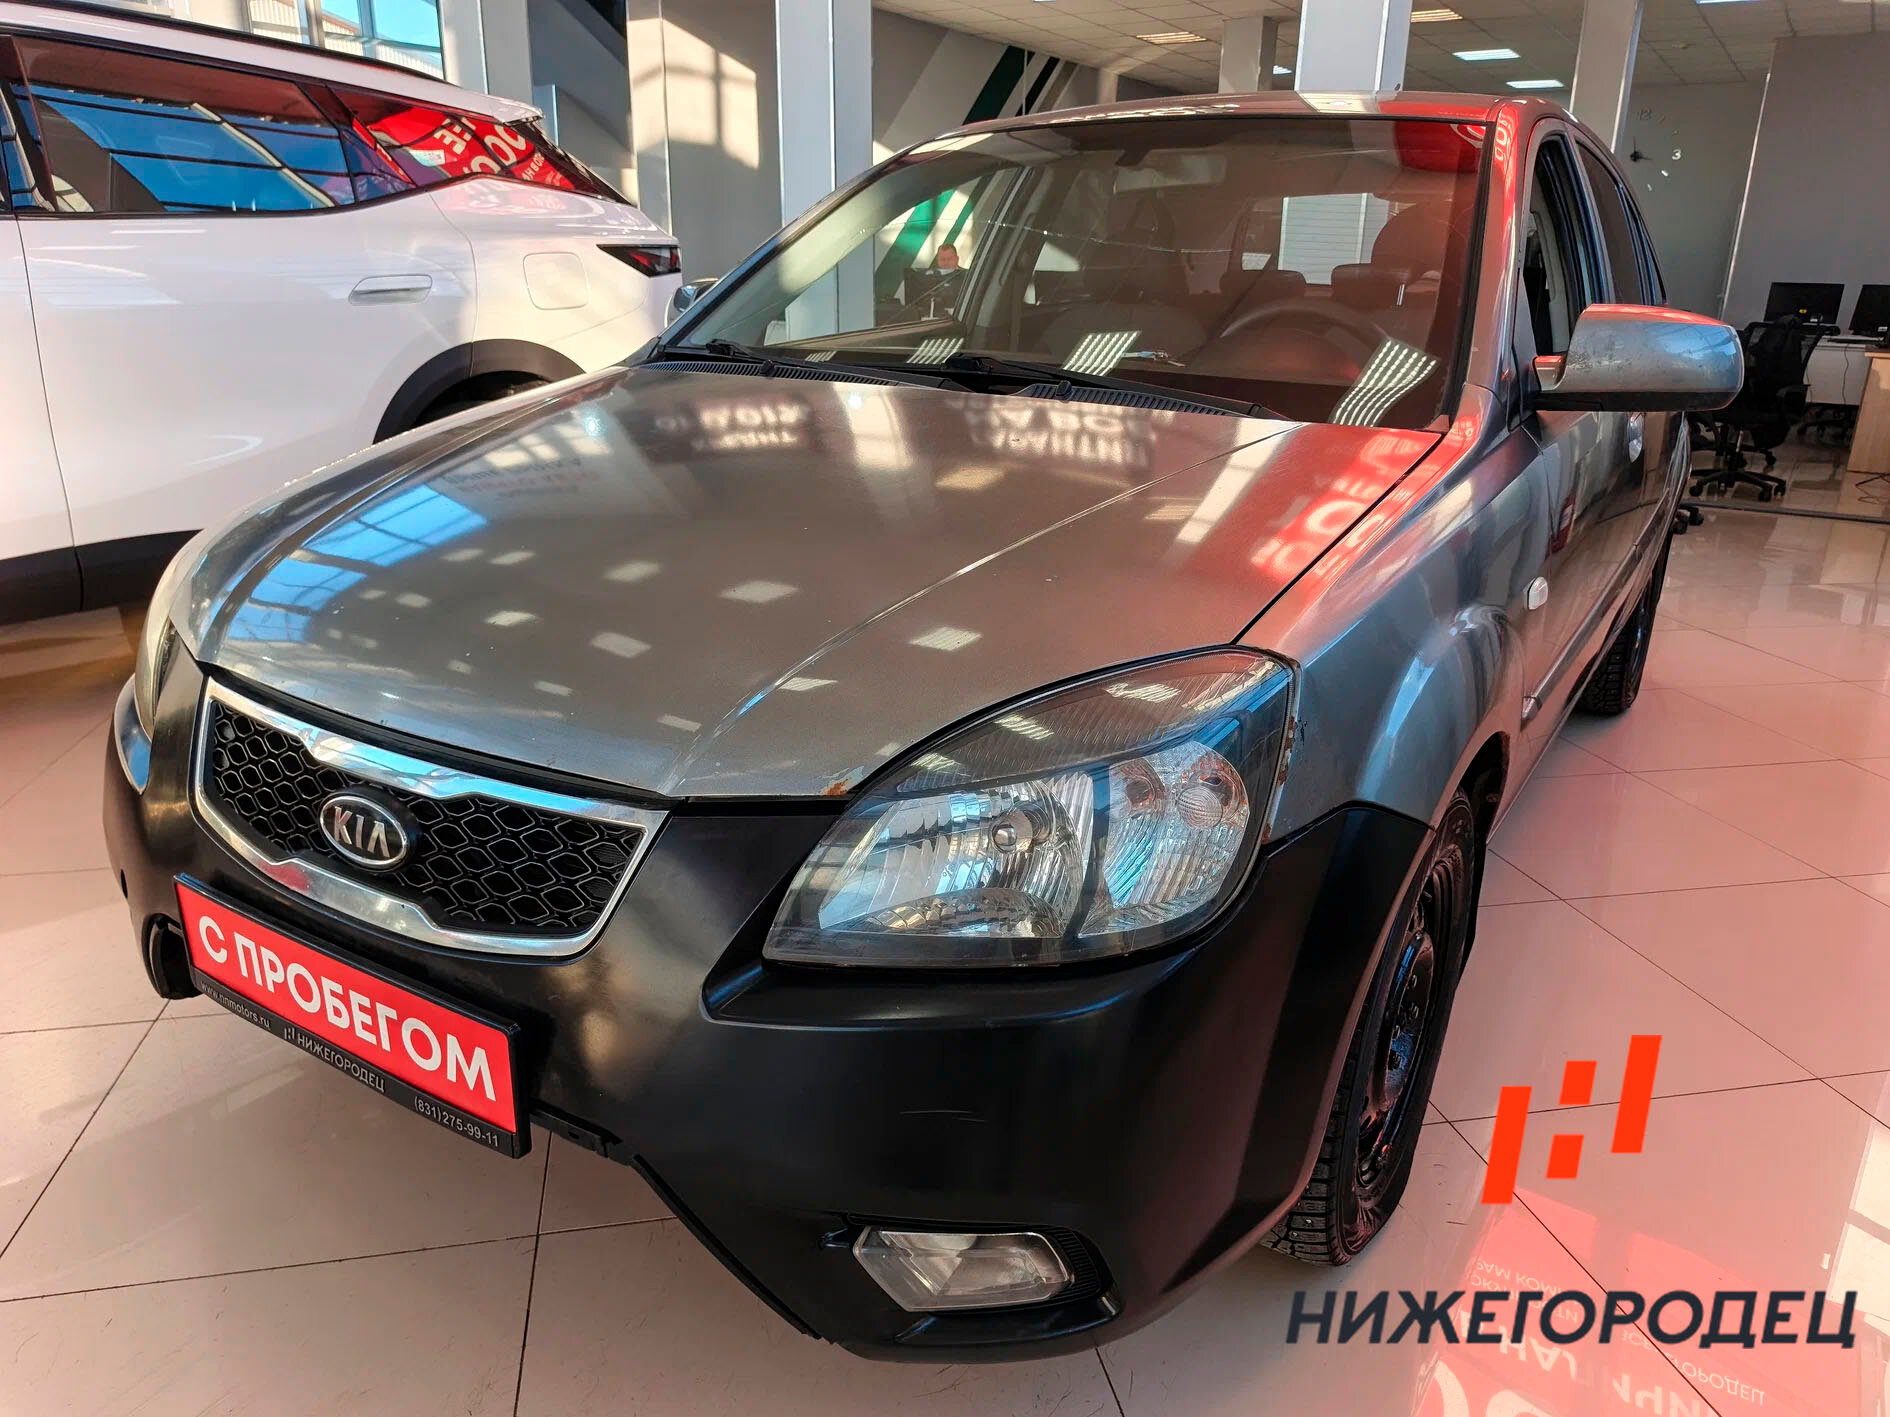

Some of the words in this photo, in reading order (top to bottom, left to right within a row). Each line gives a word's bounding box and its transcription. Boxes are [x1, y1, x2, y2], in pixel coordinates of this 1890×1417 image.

[1672, 149, 1682, 160] 3
[334, 806, 390, 858] KIA
[199, 915, 228, 964] С
[234, 931, 497, 1102] ПРОБЕГОМ
[201, 981, 271, 1030] www.nnmotors.ru
[297, 1032, 385, 1093] НИЖЕГОРОДЕЦ
[414, 1095, 498, 1147] (831)275-99-11
